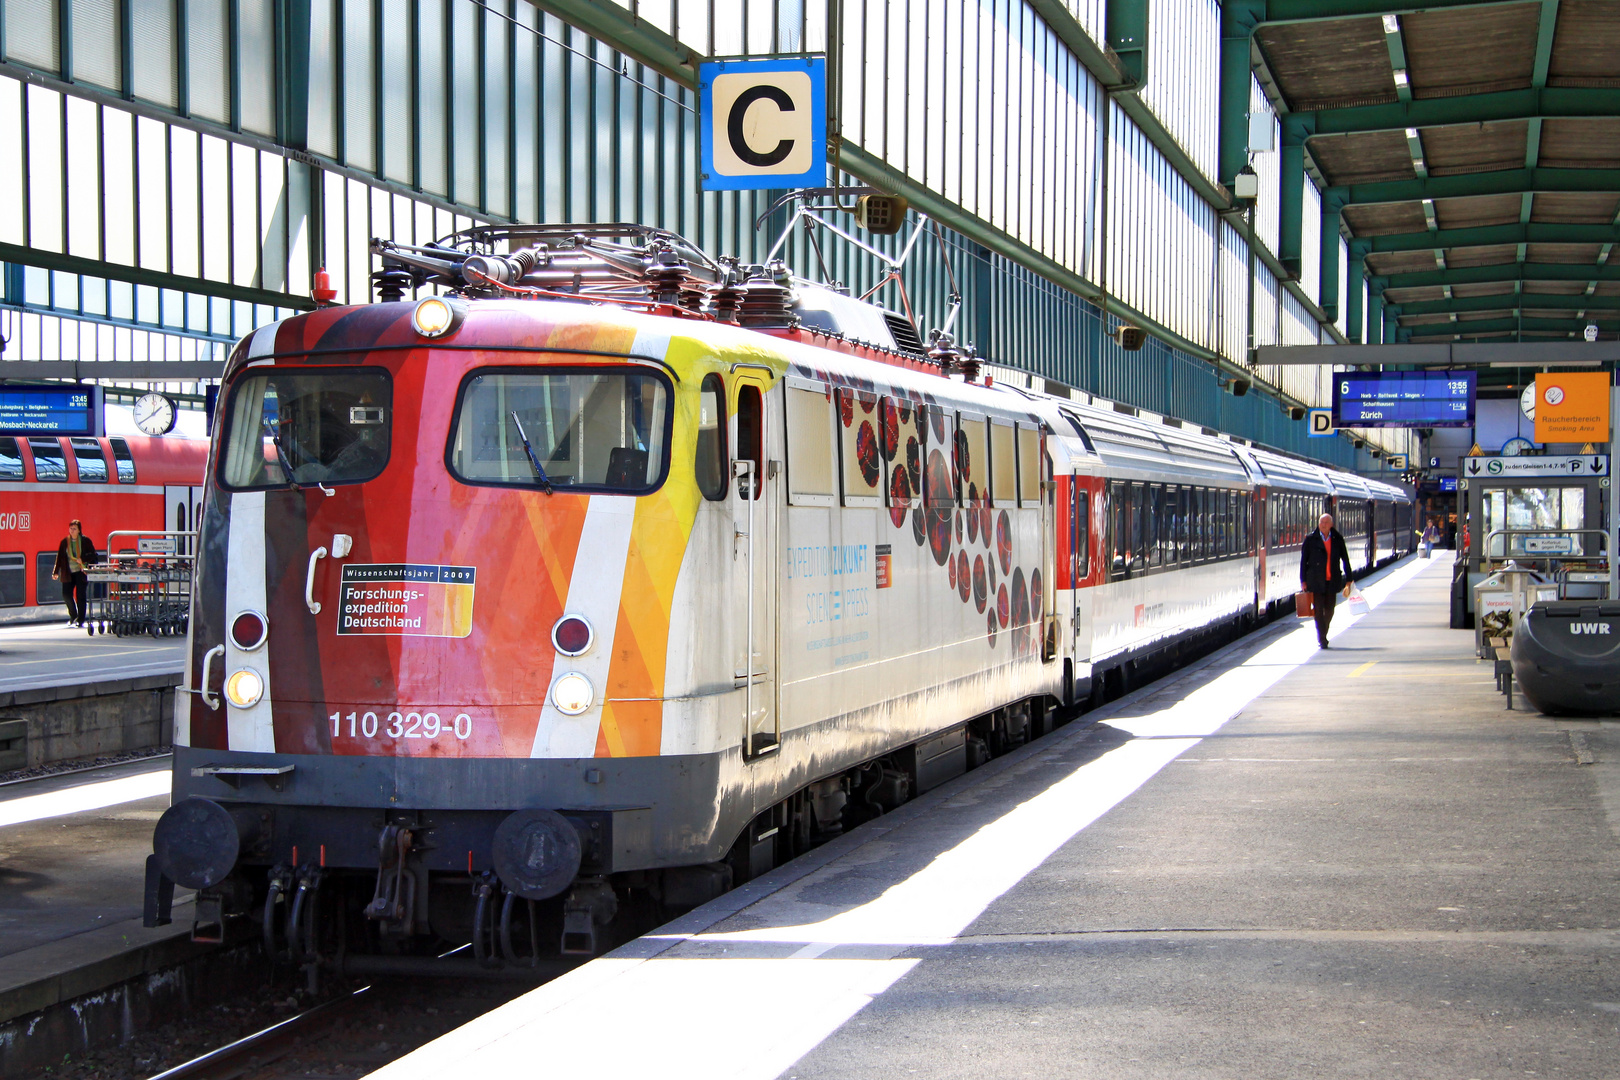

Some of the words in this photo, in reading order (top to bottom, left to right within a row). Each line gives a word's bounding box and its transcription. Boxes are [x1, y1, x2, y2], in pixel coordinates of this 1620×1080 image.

[727, 85, 795, 167] C
[1340, 381, 1349, 394] 6
[1447, 381, 1467, 389] 13:55
[1360, 411, 1382, 419] Zürich
[1314, 414, 1330, 432] D
[1394, 457, 1403, 467] E
[1430, 457, 1437, 466] 6
[1070, 481, 1075, 505] 2
[19, 514, 30, 529] DB
[346, 569, 434, 578] Wissenschaftsjahr
[443, 571, 471, 579] 2009
[346, 587, 425, 601] Forschungs-
[345, 601, 408, 616] expedition
[344, 615, 422, 628] Deutschland
[1570, 623, 1611, 635] UWR
[329, 711, 378, 738] 110
[386, 712, 472, 740] 329-0
